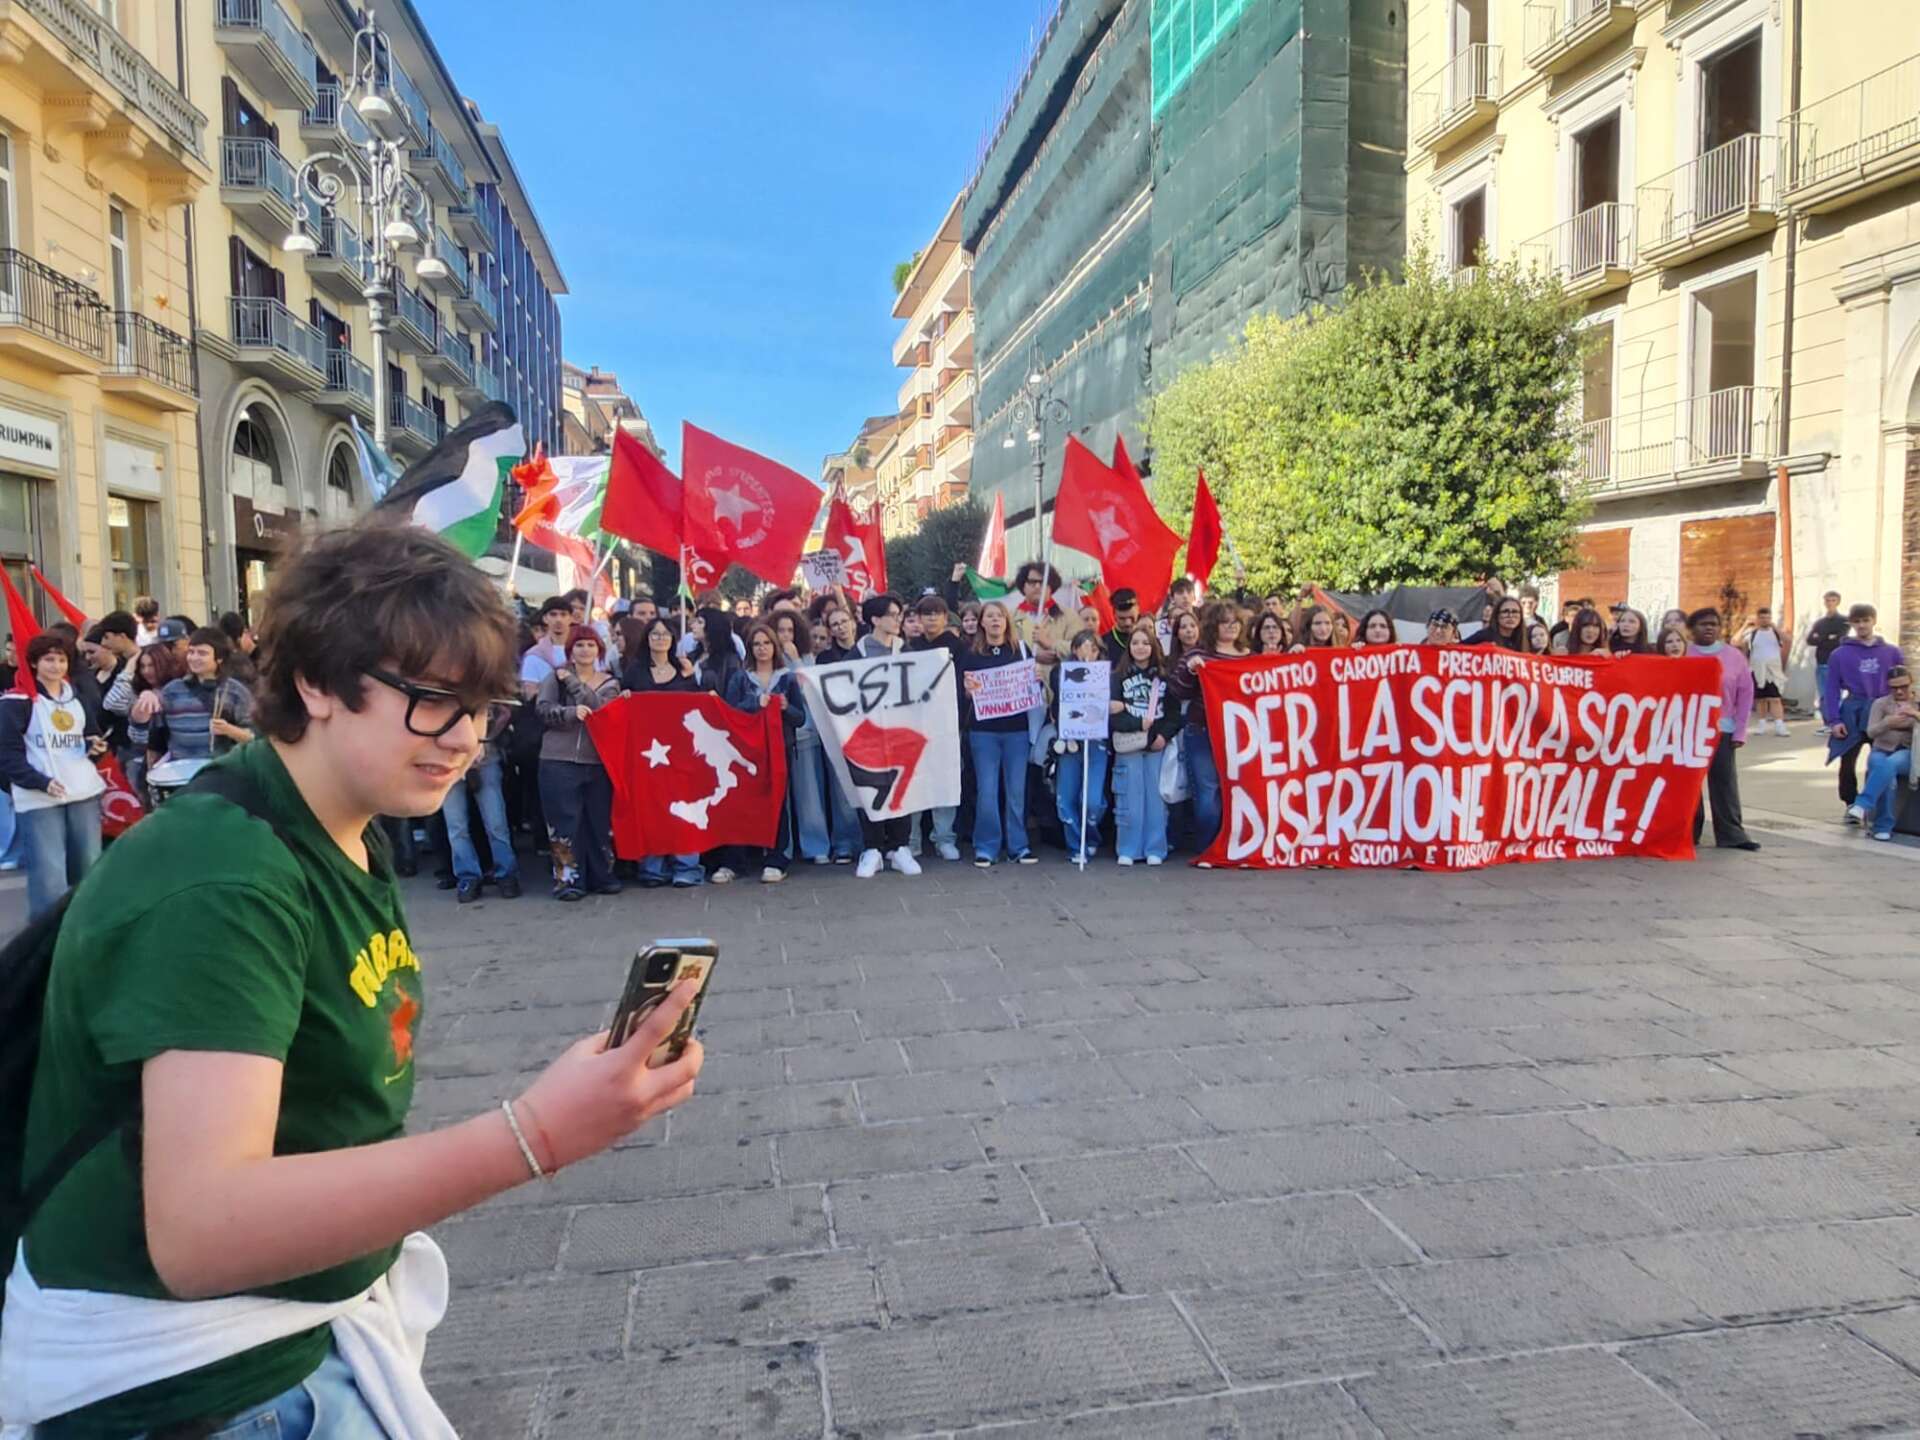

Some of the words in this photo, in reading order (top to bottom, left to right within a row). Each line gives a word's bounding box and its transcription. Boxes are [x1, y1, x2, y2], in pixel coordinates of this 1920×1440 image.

[1239, 660, 1317, 695] CONTRO
[1330, 650, 1421, 682] CAROVITA
[1222, 692, 1319, 780] PER
[1338, 677, 1402, 762] LA
[1410, 675, 1570, 759] SCUOLA
[1576, 691, 1722, 768] SOCIALE
[1227, 761, 1492, 861] DISERZIONE
